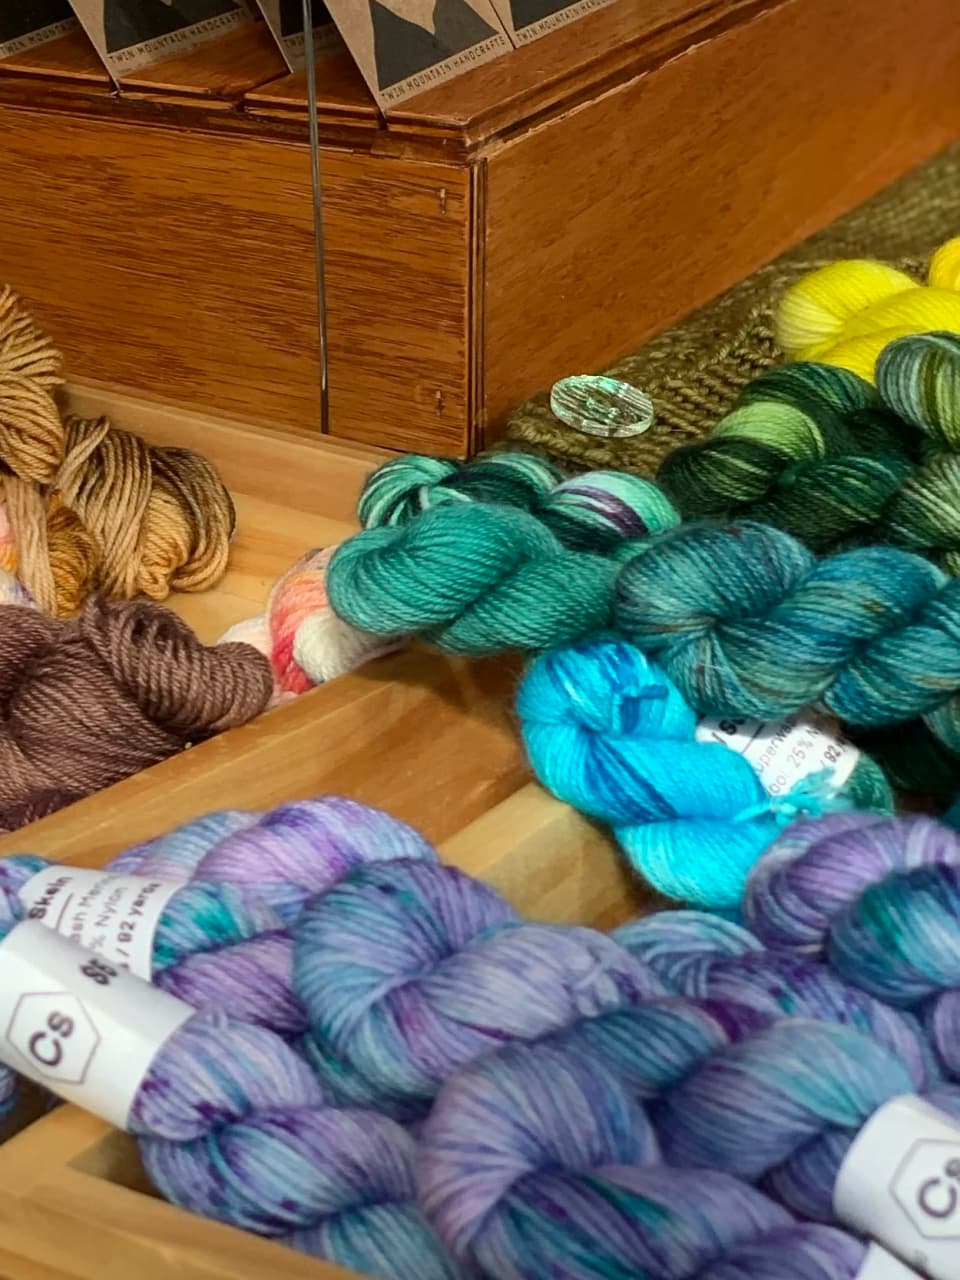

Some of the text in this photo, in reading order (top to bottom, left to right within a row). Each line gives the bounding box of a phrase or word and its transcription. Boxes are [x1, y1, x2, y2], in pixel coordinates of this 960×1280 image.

[109, 9, 246, 64] TWIN MOUNTAIN HANDCRAFTS
[516, 28, 538, 42] TWIN
[539, 8, 580, 30] MOUNTAIN
[381, 35, 507, 102] TWIN MOUNTAIN HANDCRAFTS
[787, 738, 814, 768] 25%
[823, 744, 841, 763] 92
[28, 876, 74, 919] Skein
[94, 886, 129, 927] Nylon
[28, 1010, 75, 1067] Cs
